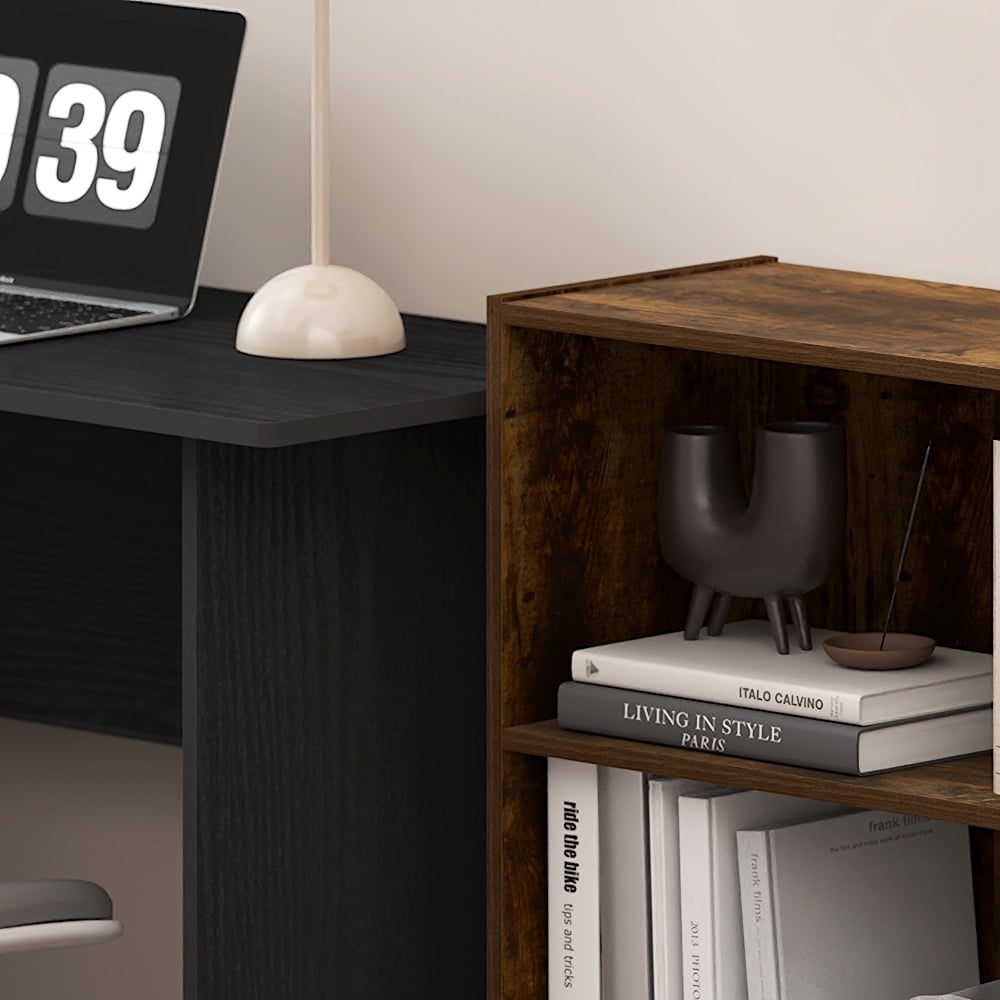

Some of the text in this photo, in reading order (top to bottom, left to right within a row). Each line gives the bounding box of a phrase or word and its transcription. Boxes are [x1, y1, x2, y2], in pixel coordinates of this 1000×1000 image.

[36, 82, 166, 211] 39
[739, 686, 771, 702] ITALO
[775, 692, 824, 710] CALVINO
[623, 702, 782, 744] LIVING IN STYLE
[681, 732, 726, 752] PARIS
[868, 817, 900, 833] frank
[563, 801, 580, 894] ride the bike
[751, 853, 761, 887] frank
[753, 890, 764, 923] films
[562, 903, 575, 988] tips and tricks
[690, 920, 699, 948] 2013
